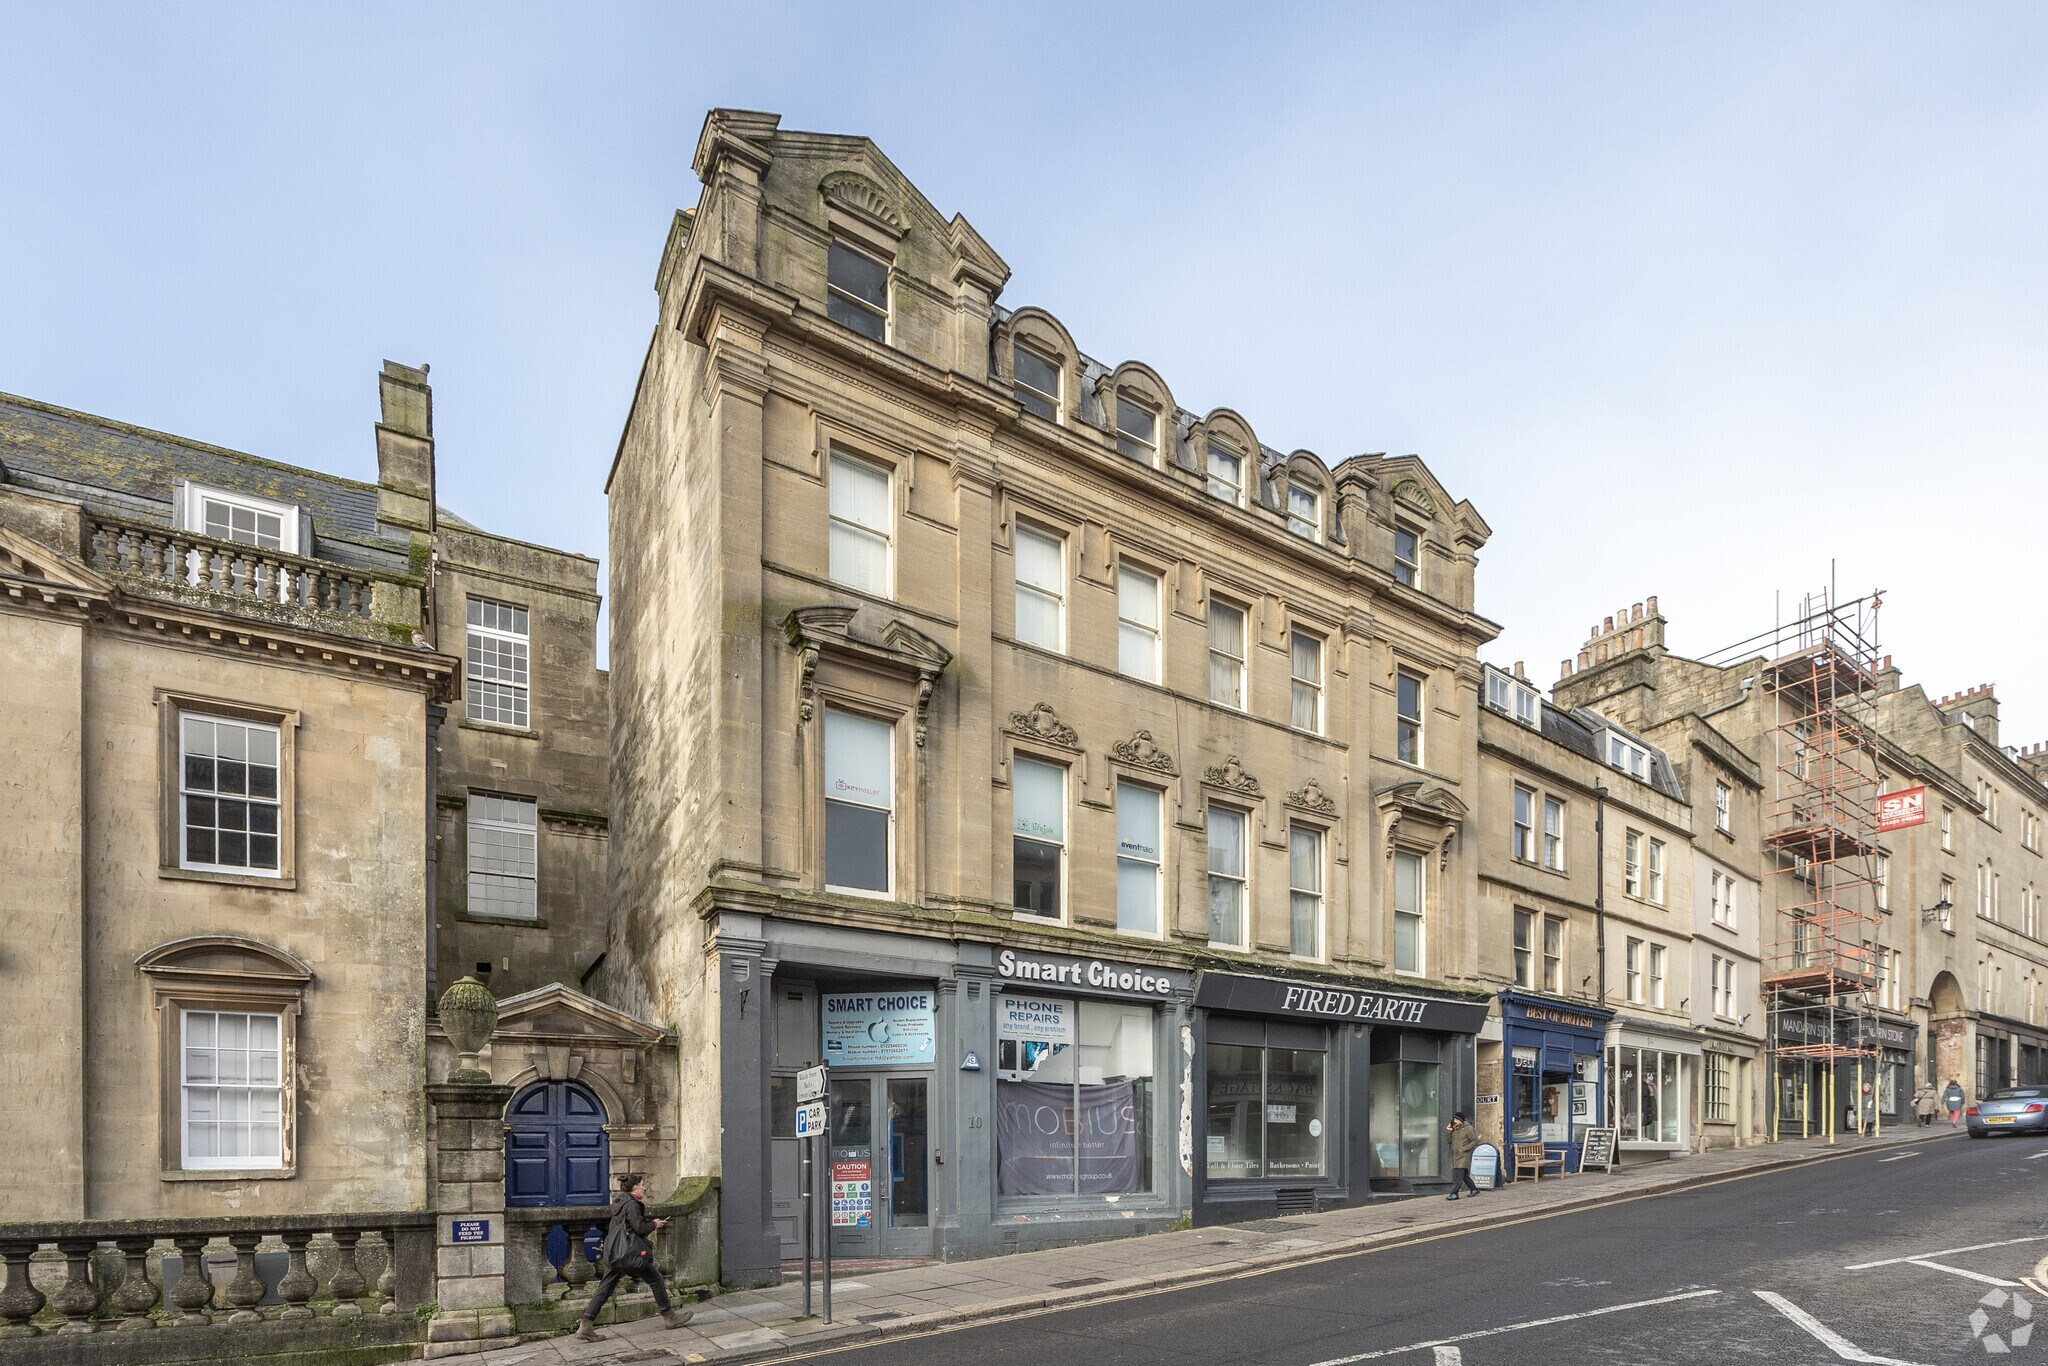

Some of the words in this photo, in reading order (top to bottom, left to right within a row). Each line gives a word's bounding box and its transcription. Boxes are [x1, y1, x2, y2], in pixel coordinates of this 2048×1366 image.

[1884, 793, 1923, 813] SN
[1120, 840, 1154, 854] eventhalo
[998, 950, 1082, 984] Smart
[1087, 961, 1171, 994] Choice
[827, 998, 873, 1013] SMART
[877, 995, 928, 1012] CHOICE
[1005, 999, 1064, 1014] PHONE
[1281, 986, 1355, 1016] FIRED
[1354, 995, 1428, 1023] EARTH
[1009, 1011, 1061, 1025] REPAIRS
[1526, 1006, 1548, 1021] BEST
[1549, 1012, 1560, 1023] OF
[1561, 1013, 1593, 1030] BRITISH
[808, 1107, 821, 1119] CAR
[808, 1120, 822, 1132] PARK
[968, 1116, 983, 1129] 10
[1045, 1173, 1113, 1182] www.mobsgroup.co.uk
